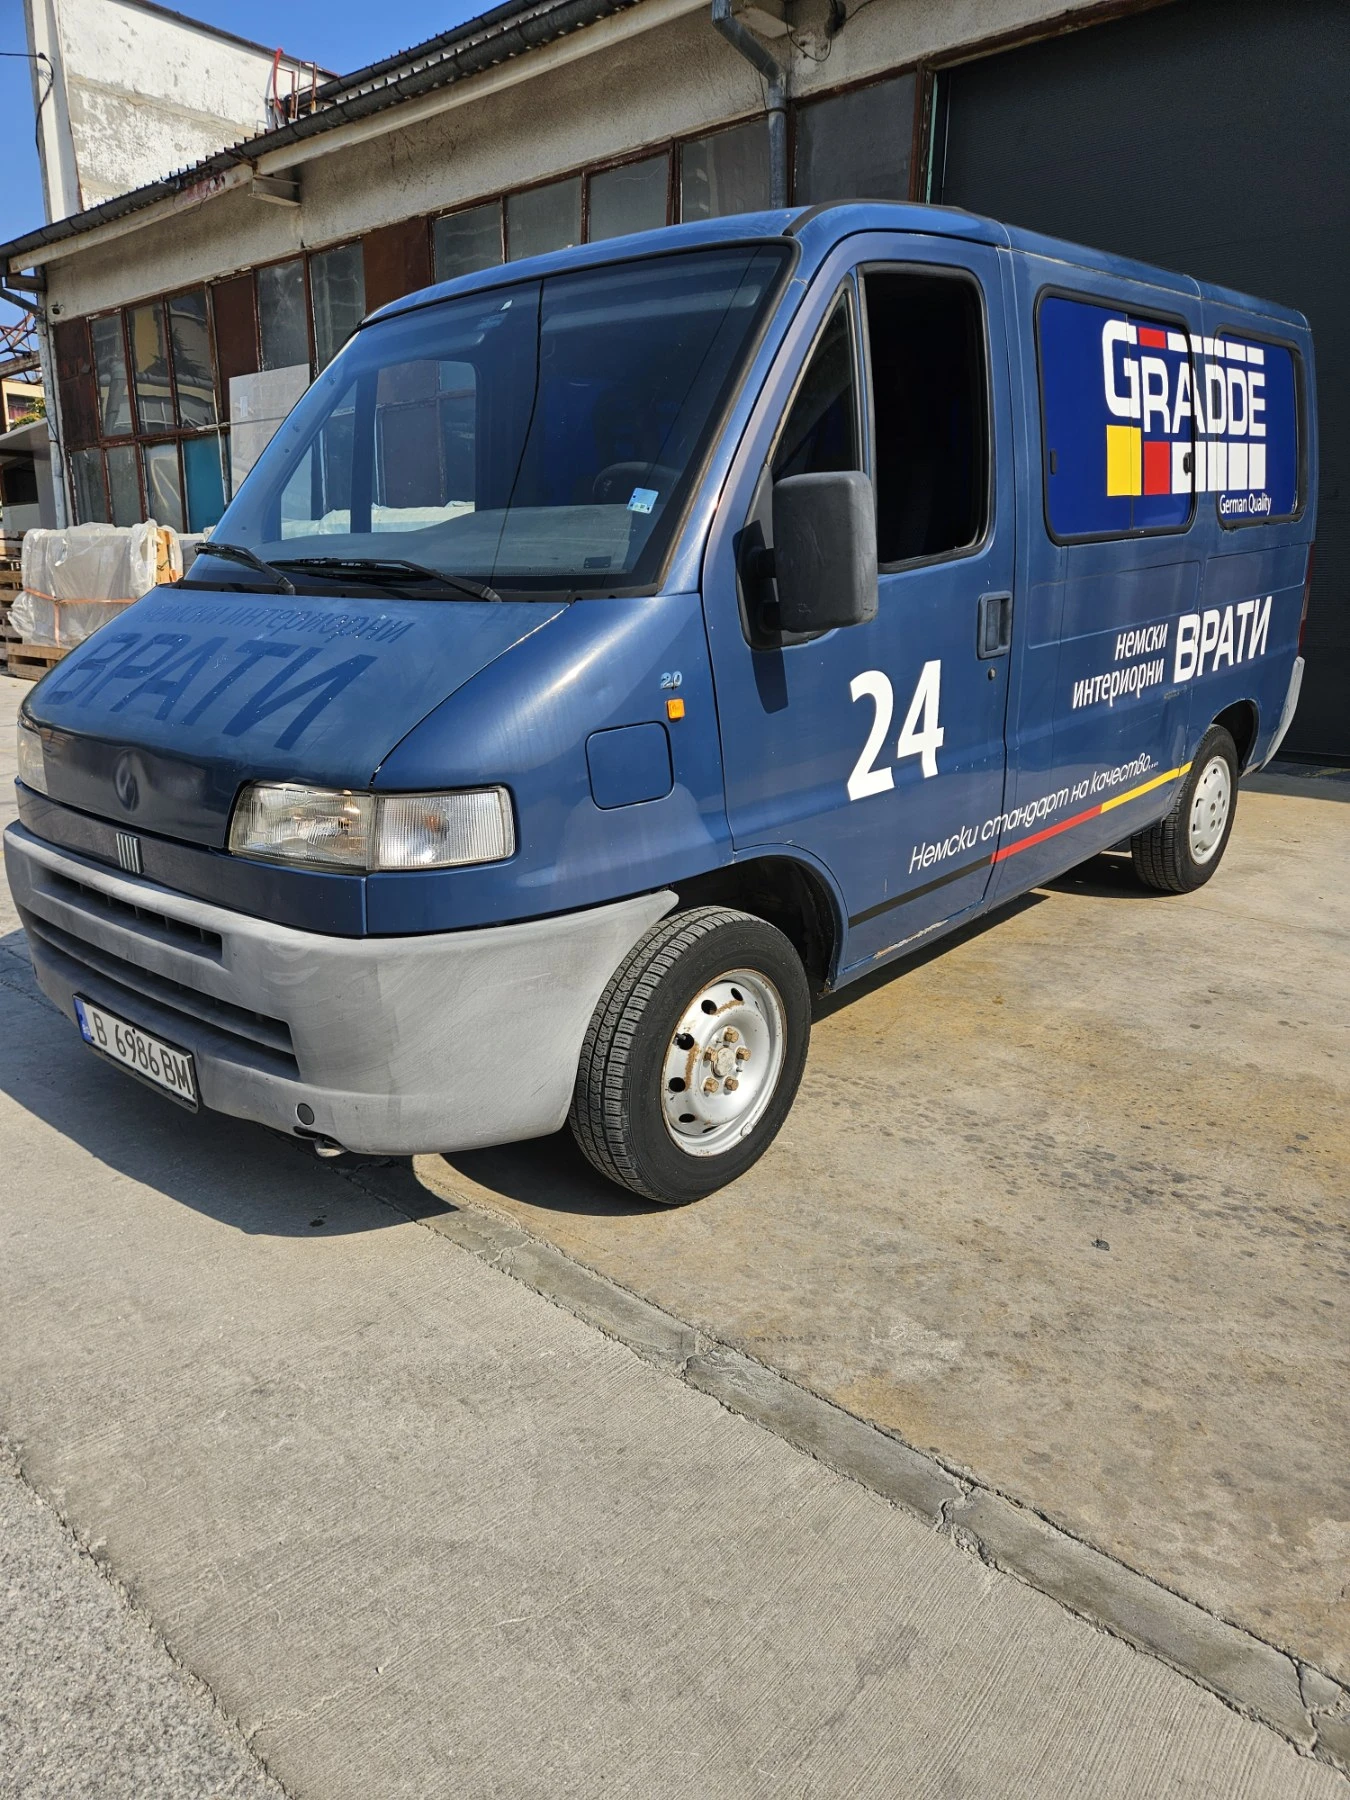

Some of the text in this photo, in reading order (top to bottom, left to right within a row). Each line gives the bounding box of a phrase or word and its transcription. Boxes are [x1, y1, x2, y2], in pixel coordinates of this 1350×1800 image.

[1102, 319, 1266, 436] GRADDE
[1220, 492, 1272, 516] German Quality
[660, 670, 683, 690] 20
[1173, 596, 1272, 684] ВРАТИ
[847, 659, 945, 801] 24
[908, 825, 978, 874] Немски
[981, 788, 1069, 841] стандарт
[1070, 778, 1089, 803] на
